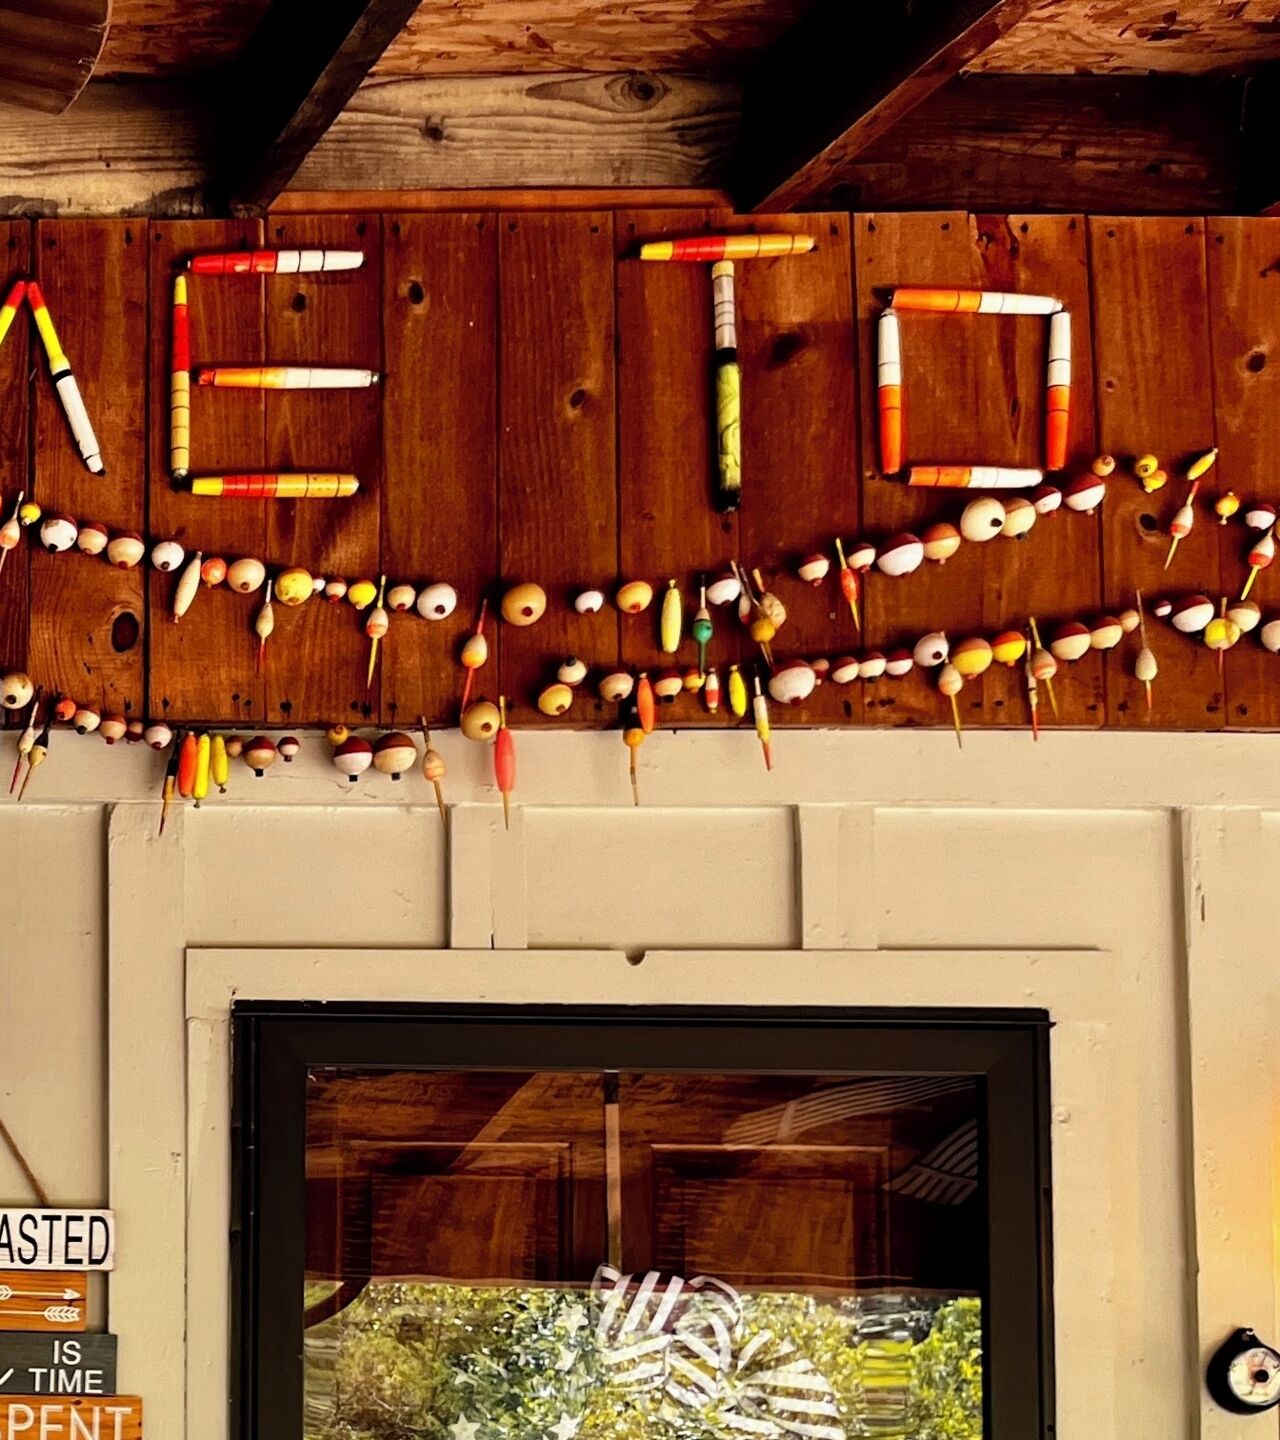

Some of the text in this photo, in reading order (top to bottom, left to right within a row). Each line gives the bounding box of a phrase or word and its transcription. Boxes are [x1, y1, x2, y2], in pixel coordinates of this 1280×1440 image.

[639, 232, 1067, 510] TO
[52, 1340, 82, 1366] IS
[28, 1368, 104, 1395] TIME
